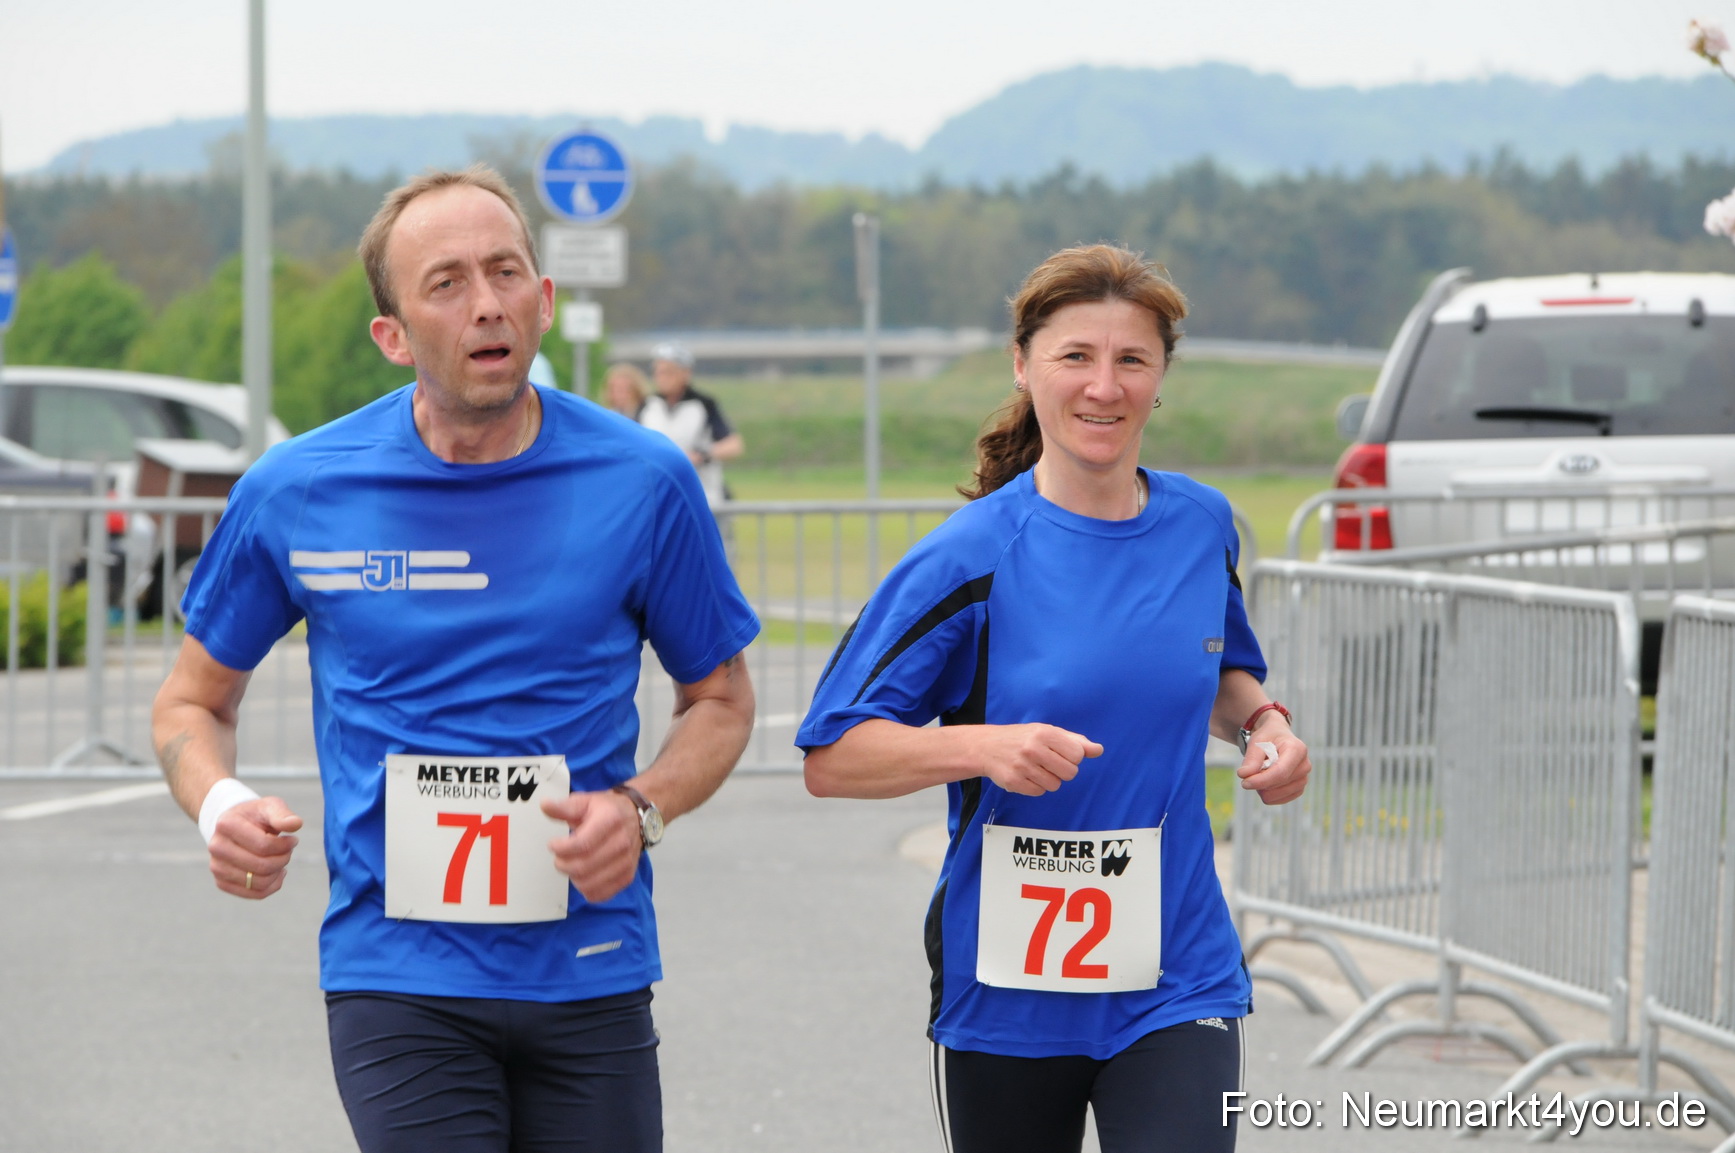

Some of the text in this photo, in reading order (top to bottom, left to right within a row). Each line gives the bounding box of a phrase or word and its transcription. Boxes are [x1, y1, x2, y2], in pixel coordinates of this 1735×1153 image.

[417, 764, 500, 783] MEYER
[417, 783, 501, 800] WERBUNG
[1012, 836, 1095, 858] MEYER
[437, 812, 509, 906] 71
[1012, 855, 1095, 873] WERBUNG
[1021, 883, 1112, 979] 72
[1196, 1017, 1228, 1031] adidas
